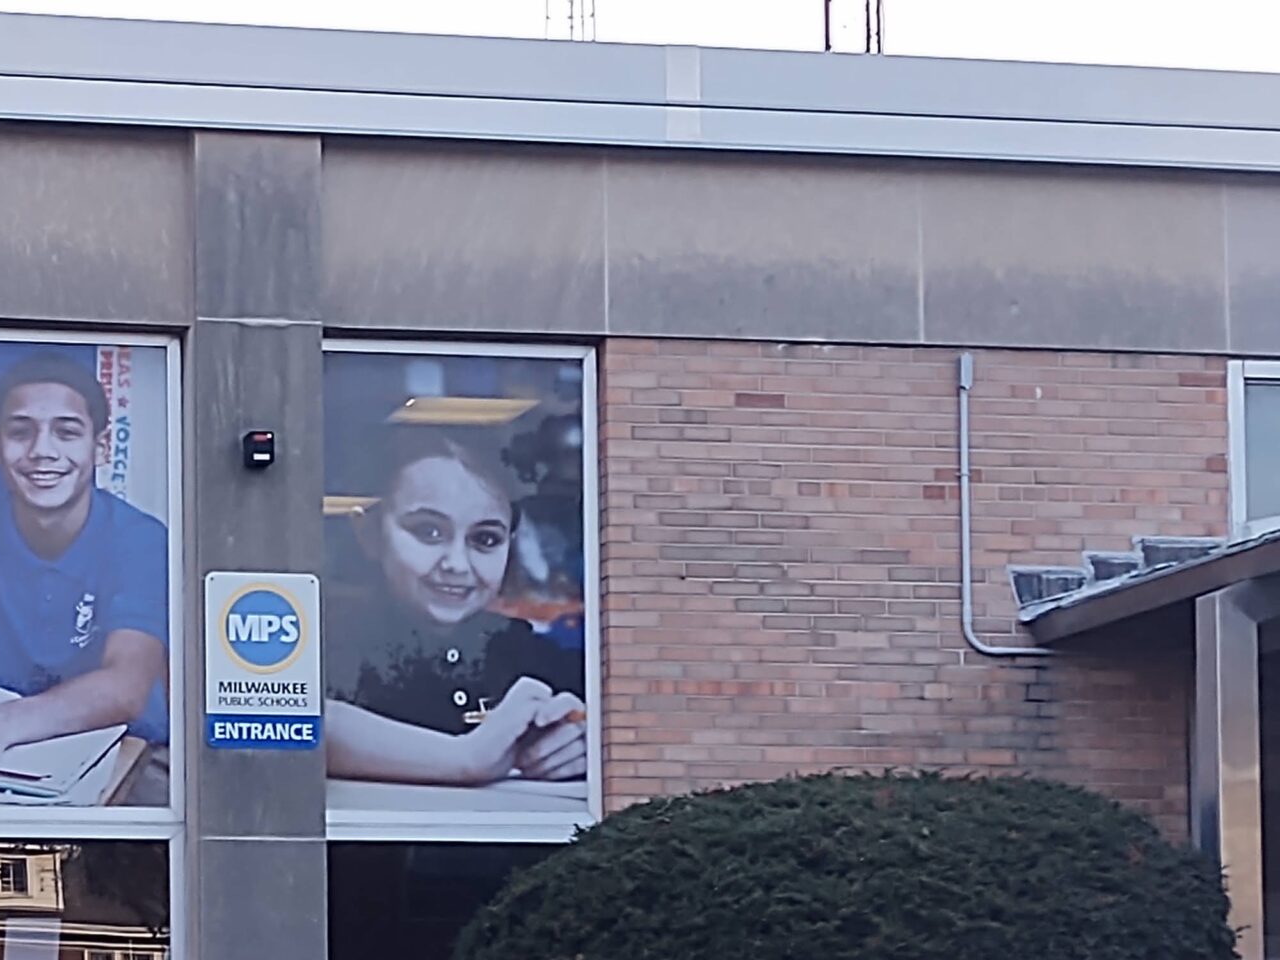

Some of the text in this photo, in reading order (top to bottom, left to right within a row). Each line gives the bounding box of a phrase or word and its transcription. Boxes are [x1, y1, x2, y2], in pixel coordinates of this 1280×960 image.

[117, 347, 132, 388] EAS
[228, 613, 299, 643] MPS
[218, 681, 308, 695] MILWAUKEE
[218, 696, 308, 708] PUBLIC SCHOOLS
[214, 721, 314, 741] ENTRANCE
